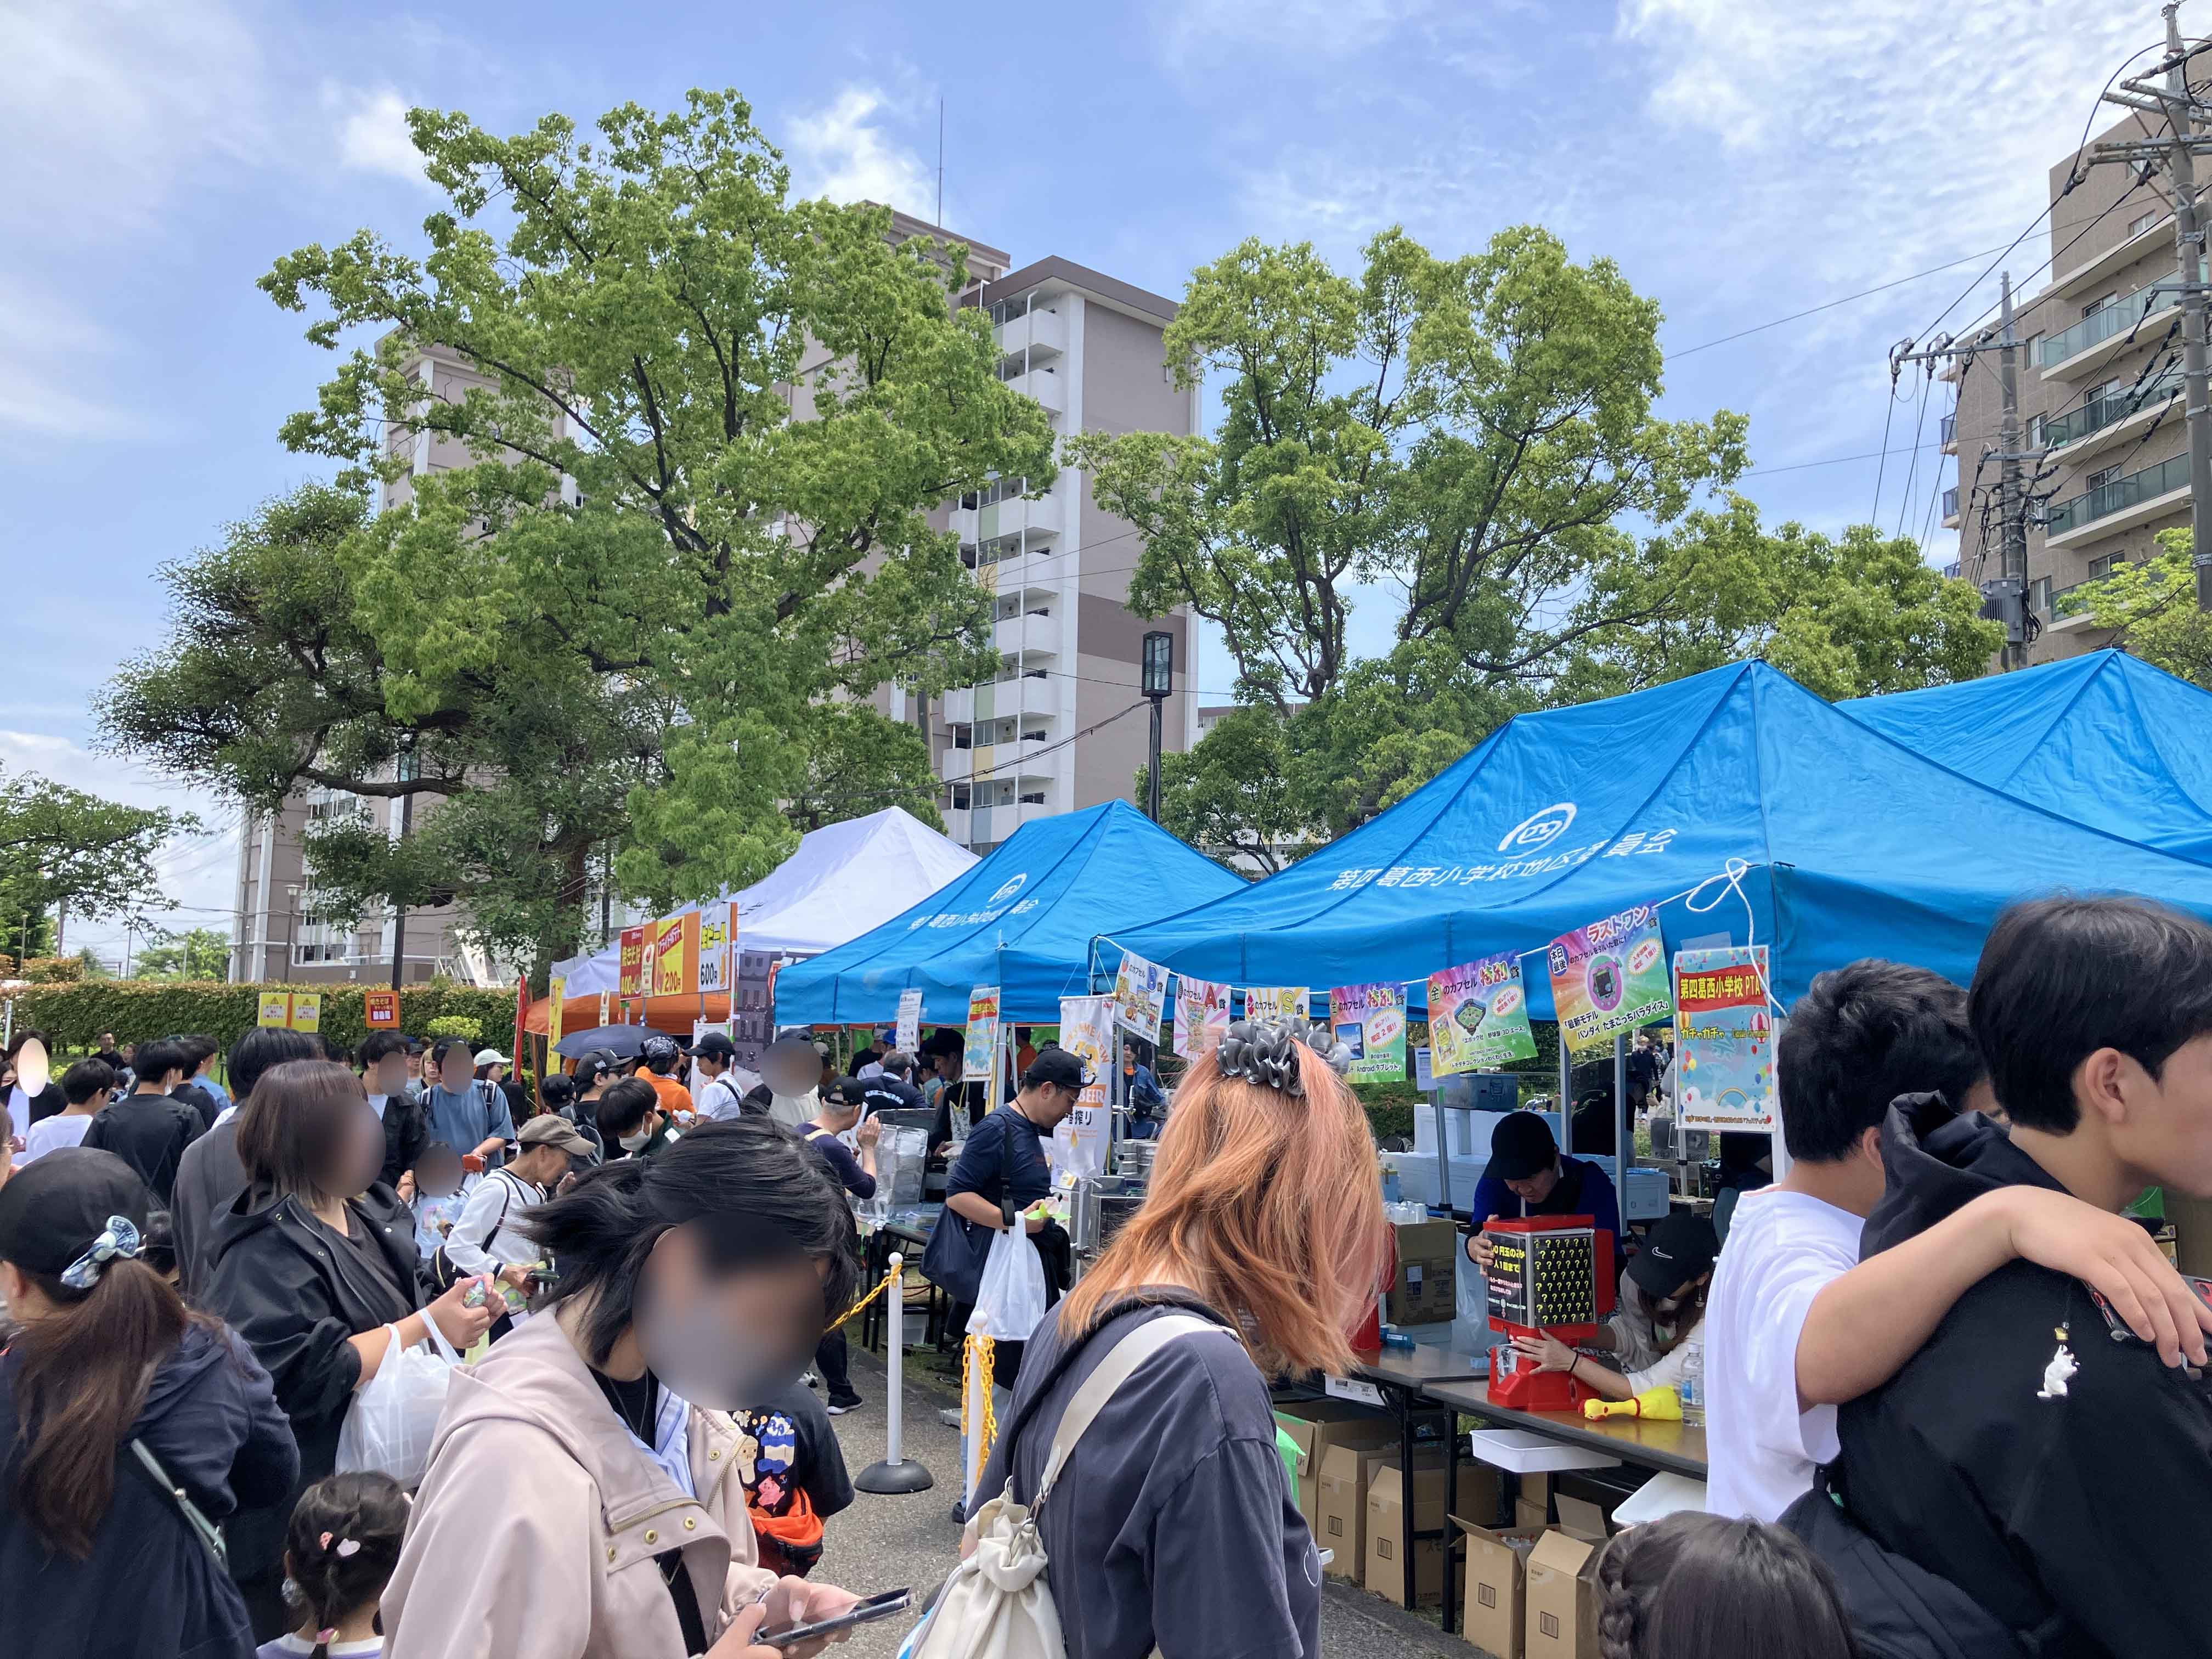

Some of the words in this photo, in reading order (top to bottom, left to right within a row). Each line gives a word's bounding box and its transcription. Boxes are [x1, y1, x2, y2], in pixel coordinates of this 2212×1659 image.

[1587, 905, 1649, 943] ラストワン
[1550, 946, 1563, 960] 本日
[1553, 956, 1566, 973] 最後
[1146, 963, 1158, 992] B
[1444, 979, 1477, 995] のカプセル
[1480, 961, 1508, 986] 特別
[1680, 975, 1743, 1001] 第四葛西小学校
[1745, 975, 1760, 996] PTA
[1205, 983, 1217, 1011] A
[1281, 990, 1295, 1014] S
[1339, 999, 1364, 1011] のカプセル
[1367, 988, 1393, 1008] 特別
[1578, 1024, 1600, 1040] バンダイ
[1681, 1027, 1725, 1040] ガチャガチャ
